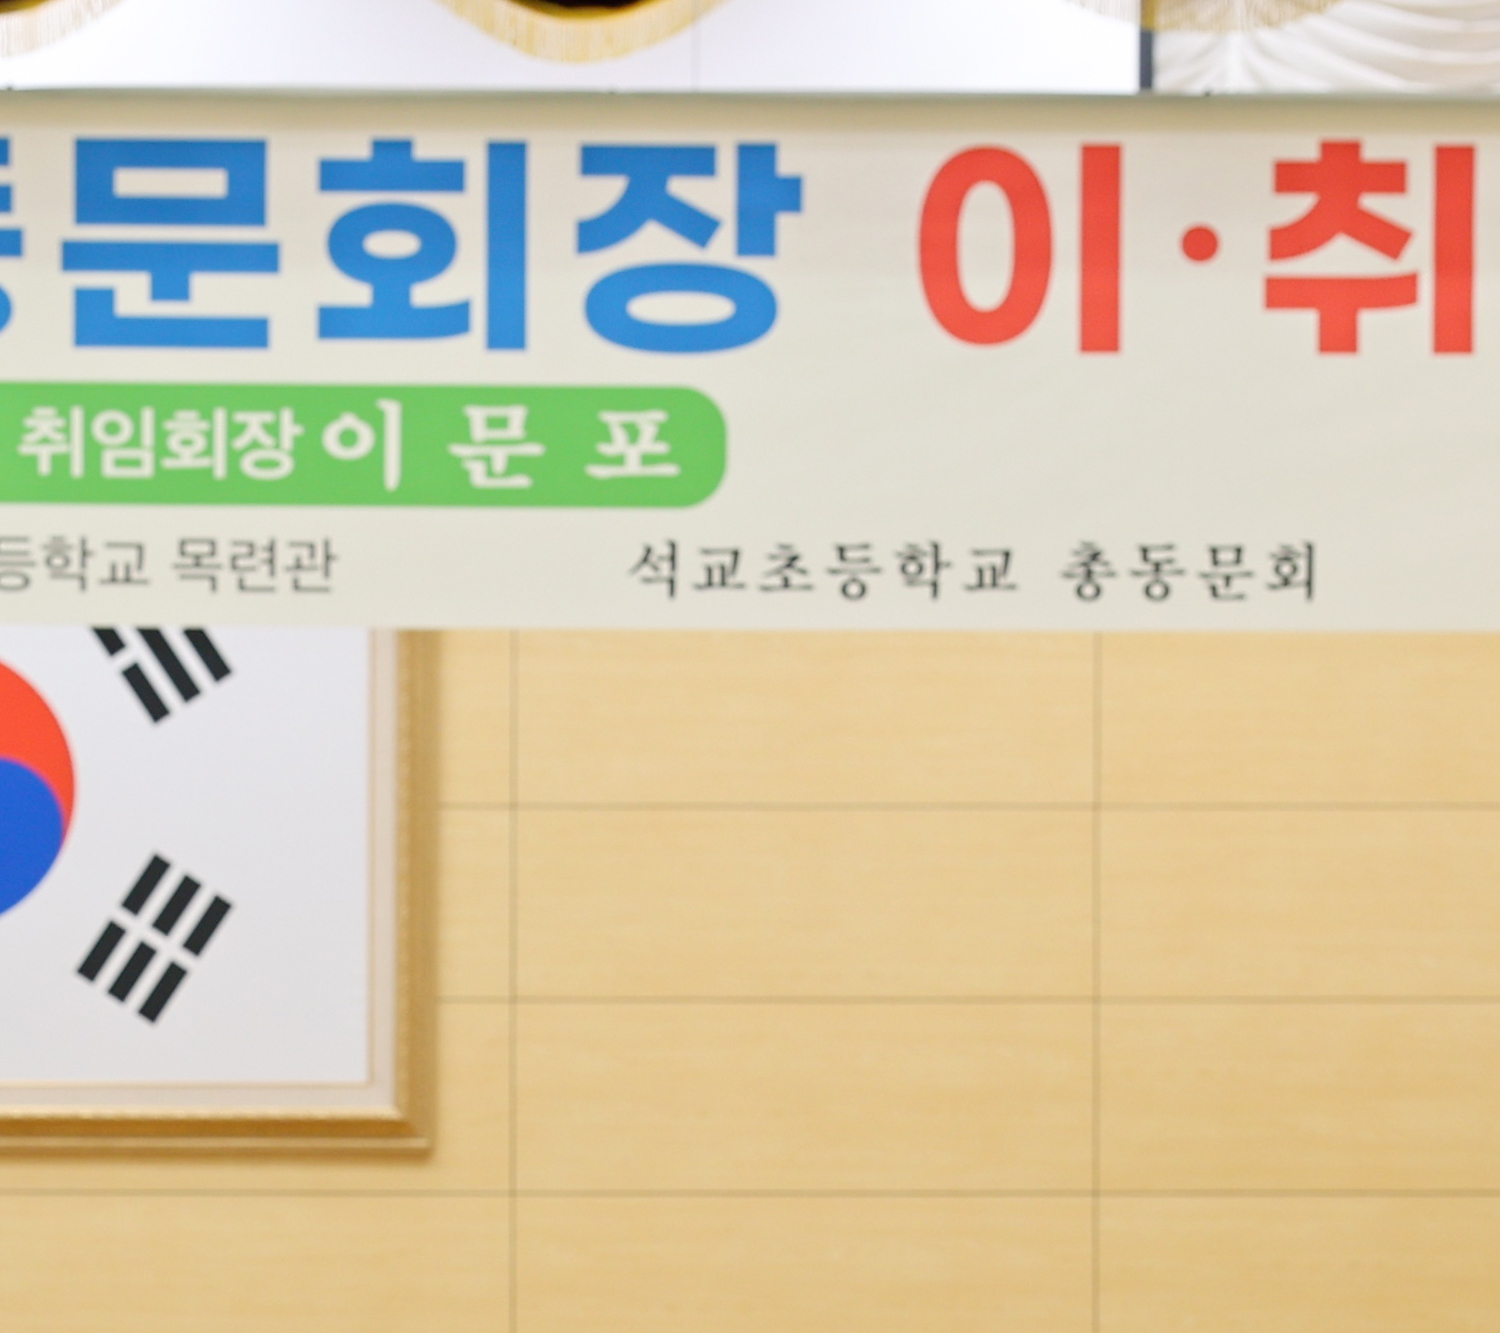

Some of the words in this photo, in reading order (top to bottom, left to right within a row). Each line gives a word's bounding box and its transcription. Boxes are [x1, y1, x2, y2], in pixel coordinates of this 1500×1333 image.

[17, 404, 304, 481] 취임회장
[171, 535, 340, 594] 목련관
[627, 537, 1020, 602] 석교초등학교
[1059, 538, 1320, 603] 총동문회
